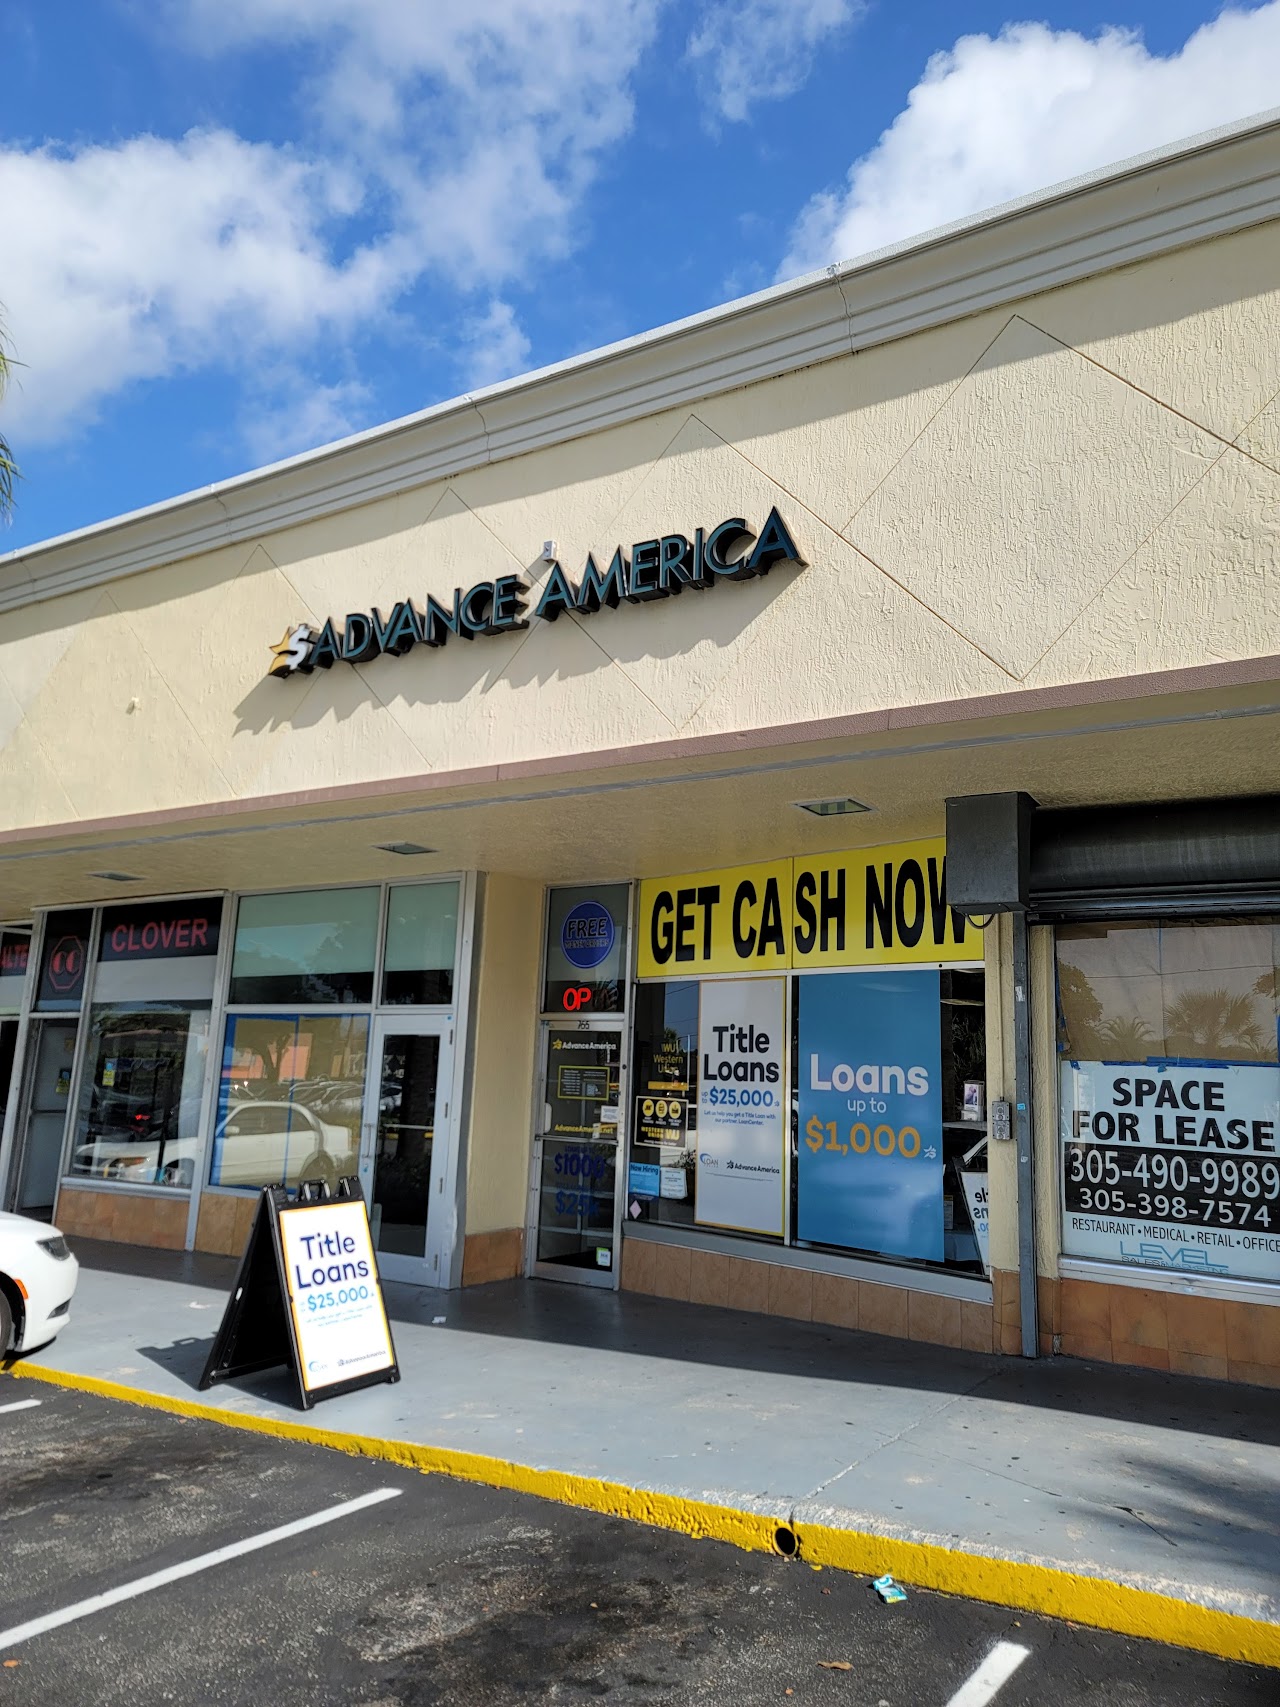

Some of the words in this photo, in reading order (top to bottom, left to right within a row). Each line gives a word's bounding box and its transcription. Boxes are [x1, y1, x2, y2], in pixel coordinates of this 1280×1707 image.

[310, 573, 530, 667] ADVANCE
[535, 505, 808, 621] AMERICA
[566, 917, 608, 939] FREE
[650, 884, 720, 964] GET
[732, 868, 846, 959] CASH
[111, 918, 208, 953] CLOVER
[712, 1023, 770, 1053] Title
[653, 1054, 684, 1064] Western
[703, 1054, 780, 1083] Loans
[810, 1053, 929, 1096] Loans
[709, 1086, 774, 1108] $25,000
[847, 1099, 866, 1116] up
[869, 1097, 887, 1114] to
[1112, 1077, 1225, 1112] SPACE
[805, 1114, 921, 1159] $1,000
[1072, 1110, 1140, 1143] FOR
[1154, 1114, 1276, 1152] LEASE
[1070, 1148, 1280, 1200] 305-490-9989
[1079, 1187, 1272, 1228] 305-398-7574
[300, 1230, 356, 1260] Title
[1072, 1217, 1136, 1236] RESTAURANT
[1143, 1225, 1190, 1243] MEDICAL
[1197, 1231, 1235, 1248] RETAIL
[1120, 1240, 1229, 1268] LEVEL
[295, 1260, 369, 1290] Loans
[307, 1285, 369, 1313] $25,000
